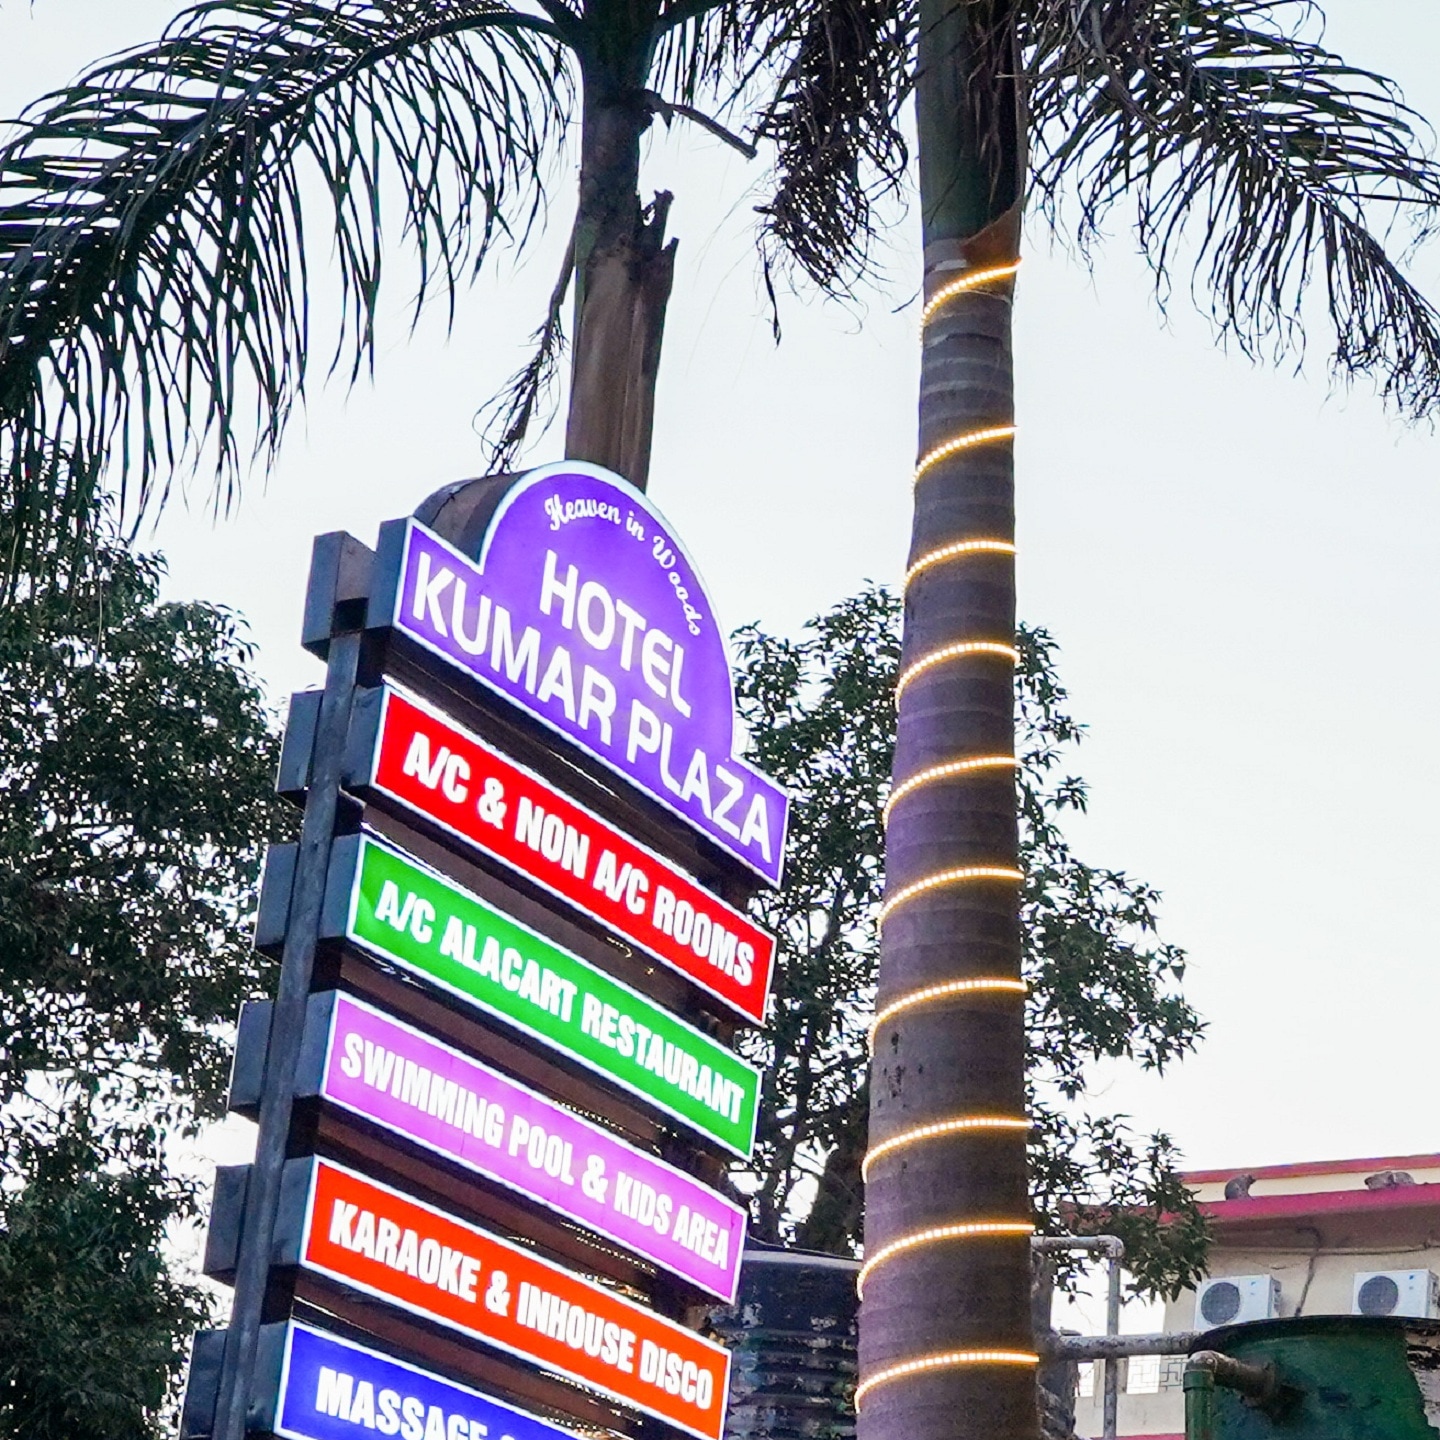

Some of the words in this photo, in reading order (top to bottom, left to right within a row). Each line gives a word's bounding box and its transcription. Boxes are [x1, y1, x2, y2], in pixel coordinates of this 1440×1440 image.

[539, 549, 691, 718] HOTEL
[544, 494, 621, 530] Heaven
[626, 510, 645, 541] in
[652, 535, 702, 636] Woods
[413, 551, 616, 745] KUMAR
[626, 700, 773, 863] PLAZA
[403, 731, 469, 805] A/C
[480, 778, 506, 828] &
[515, 801, 588, 876] NON
[596, 854, 649, 916] A/C
[653, 895, 754, 987] ROOMS
[375, 881, 435, 944] A/C
[440, 915, 576, 1024] ALACART
[581, 992, 745, 1126] RESTAURANT
[340, 1032, 504, 1148] SWIMMING
[508, 1115, 574, 1186] POOL
[581, 1154, 609, 1204] &
[613, 1171, 673, 1236] KIDS
[672, 1206, 730, 1270] AREA
[329, 1198, 481, 1301] KARAOKE
[489, 1269, 511, 1315] &
[517, 1281, 634, 1374] INHOUSE
[639, 1347, 713, 1409] DISCO
